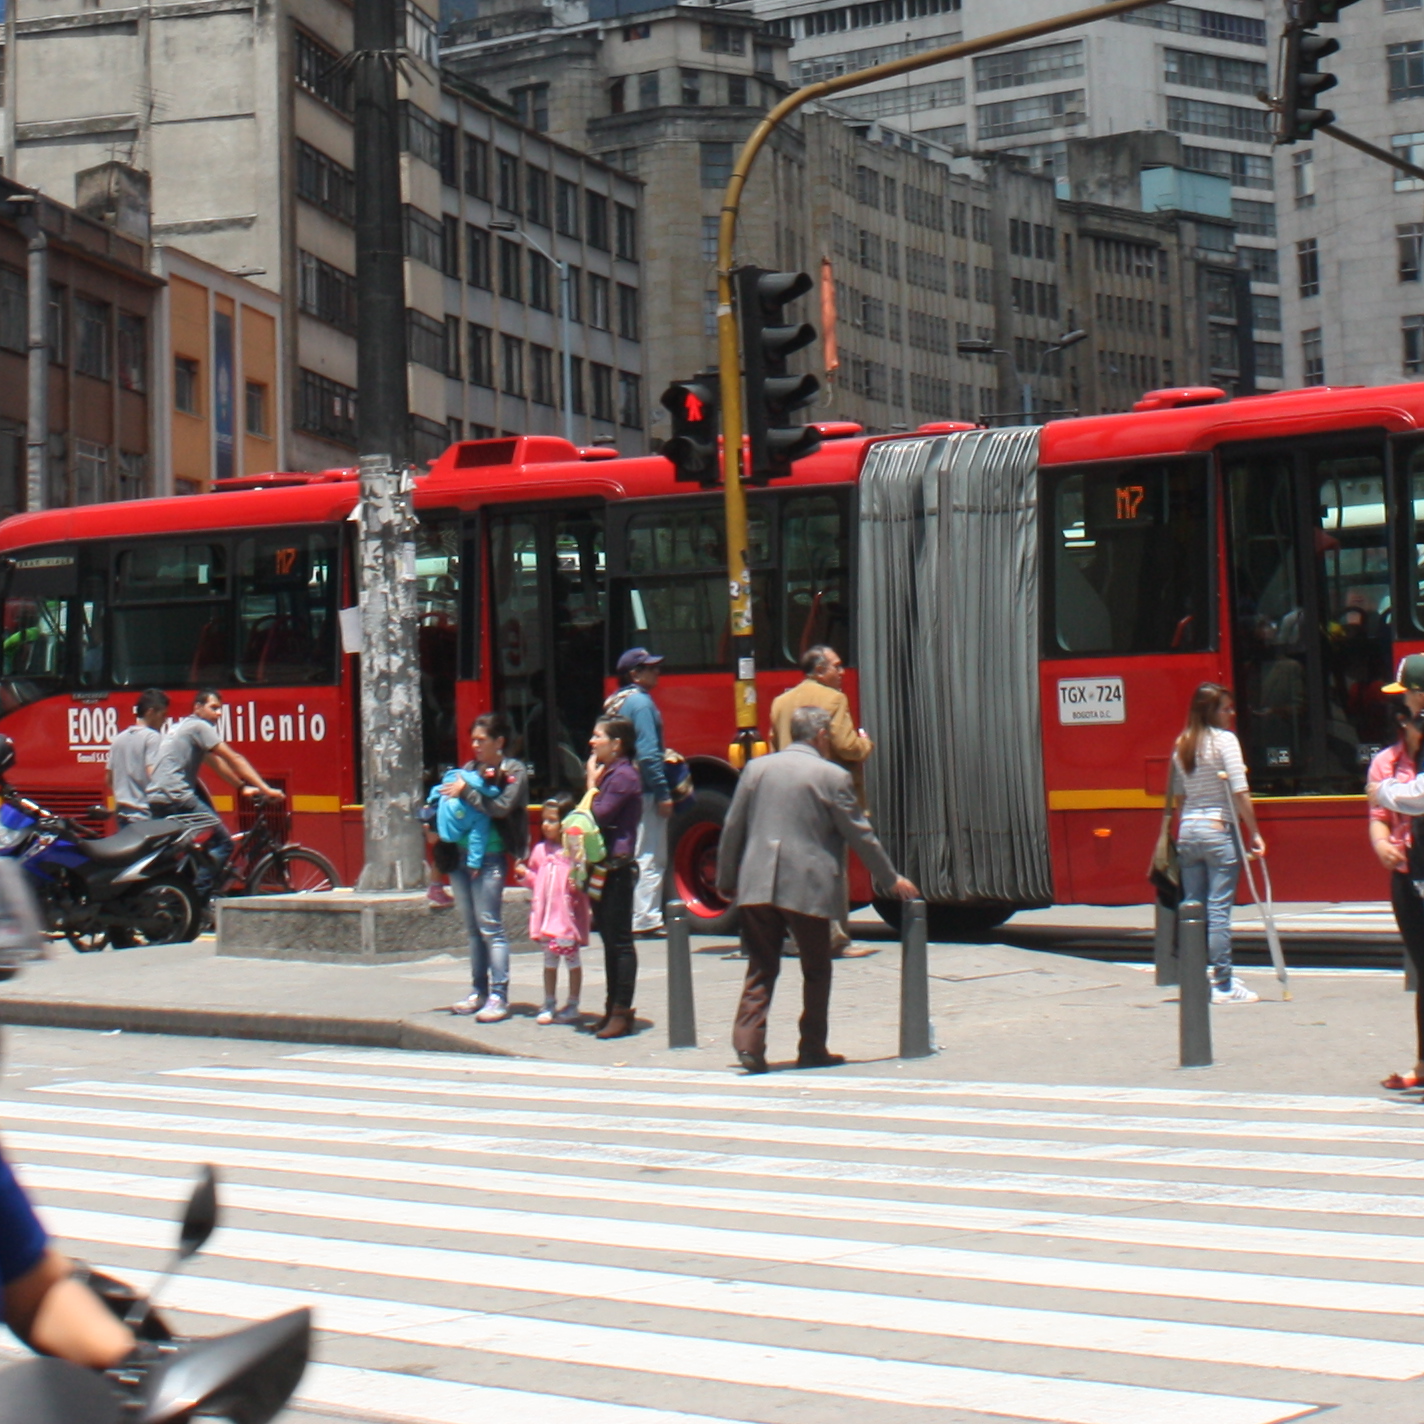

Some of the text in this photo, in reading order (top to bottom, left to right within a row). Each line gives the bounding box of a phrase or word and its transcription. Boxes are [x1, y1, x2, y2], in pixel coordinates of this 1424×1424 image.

[1116, 486, 1144, 519] M7
[1060, 685, 1121, 703] TGX 724
[68, 706, 118, 744] E008
